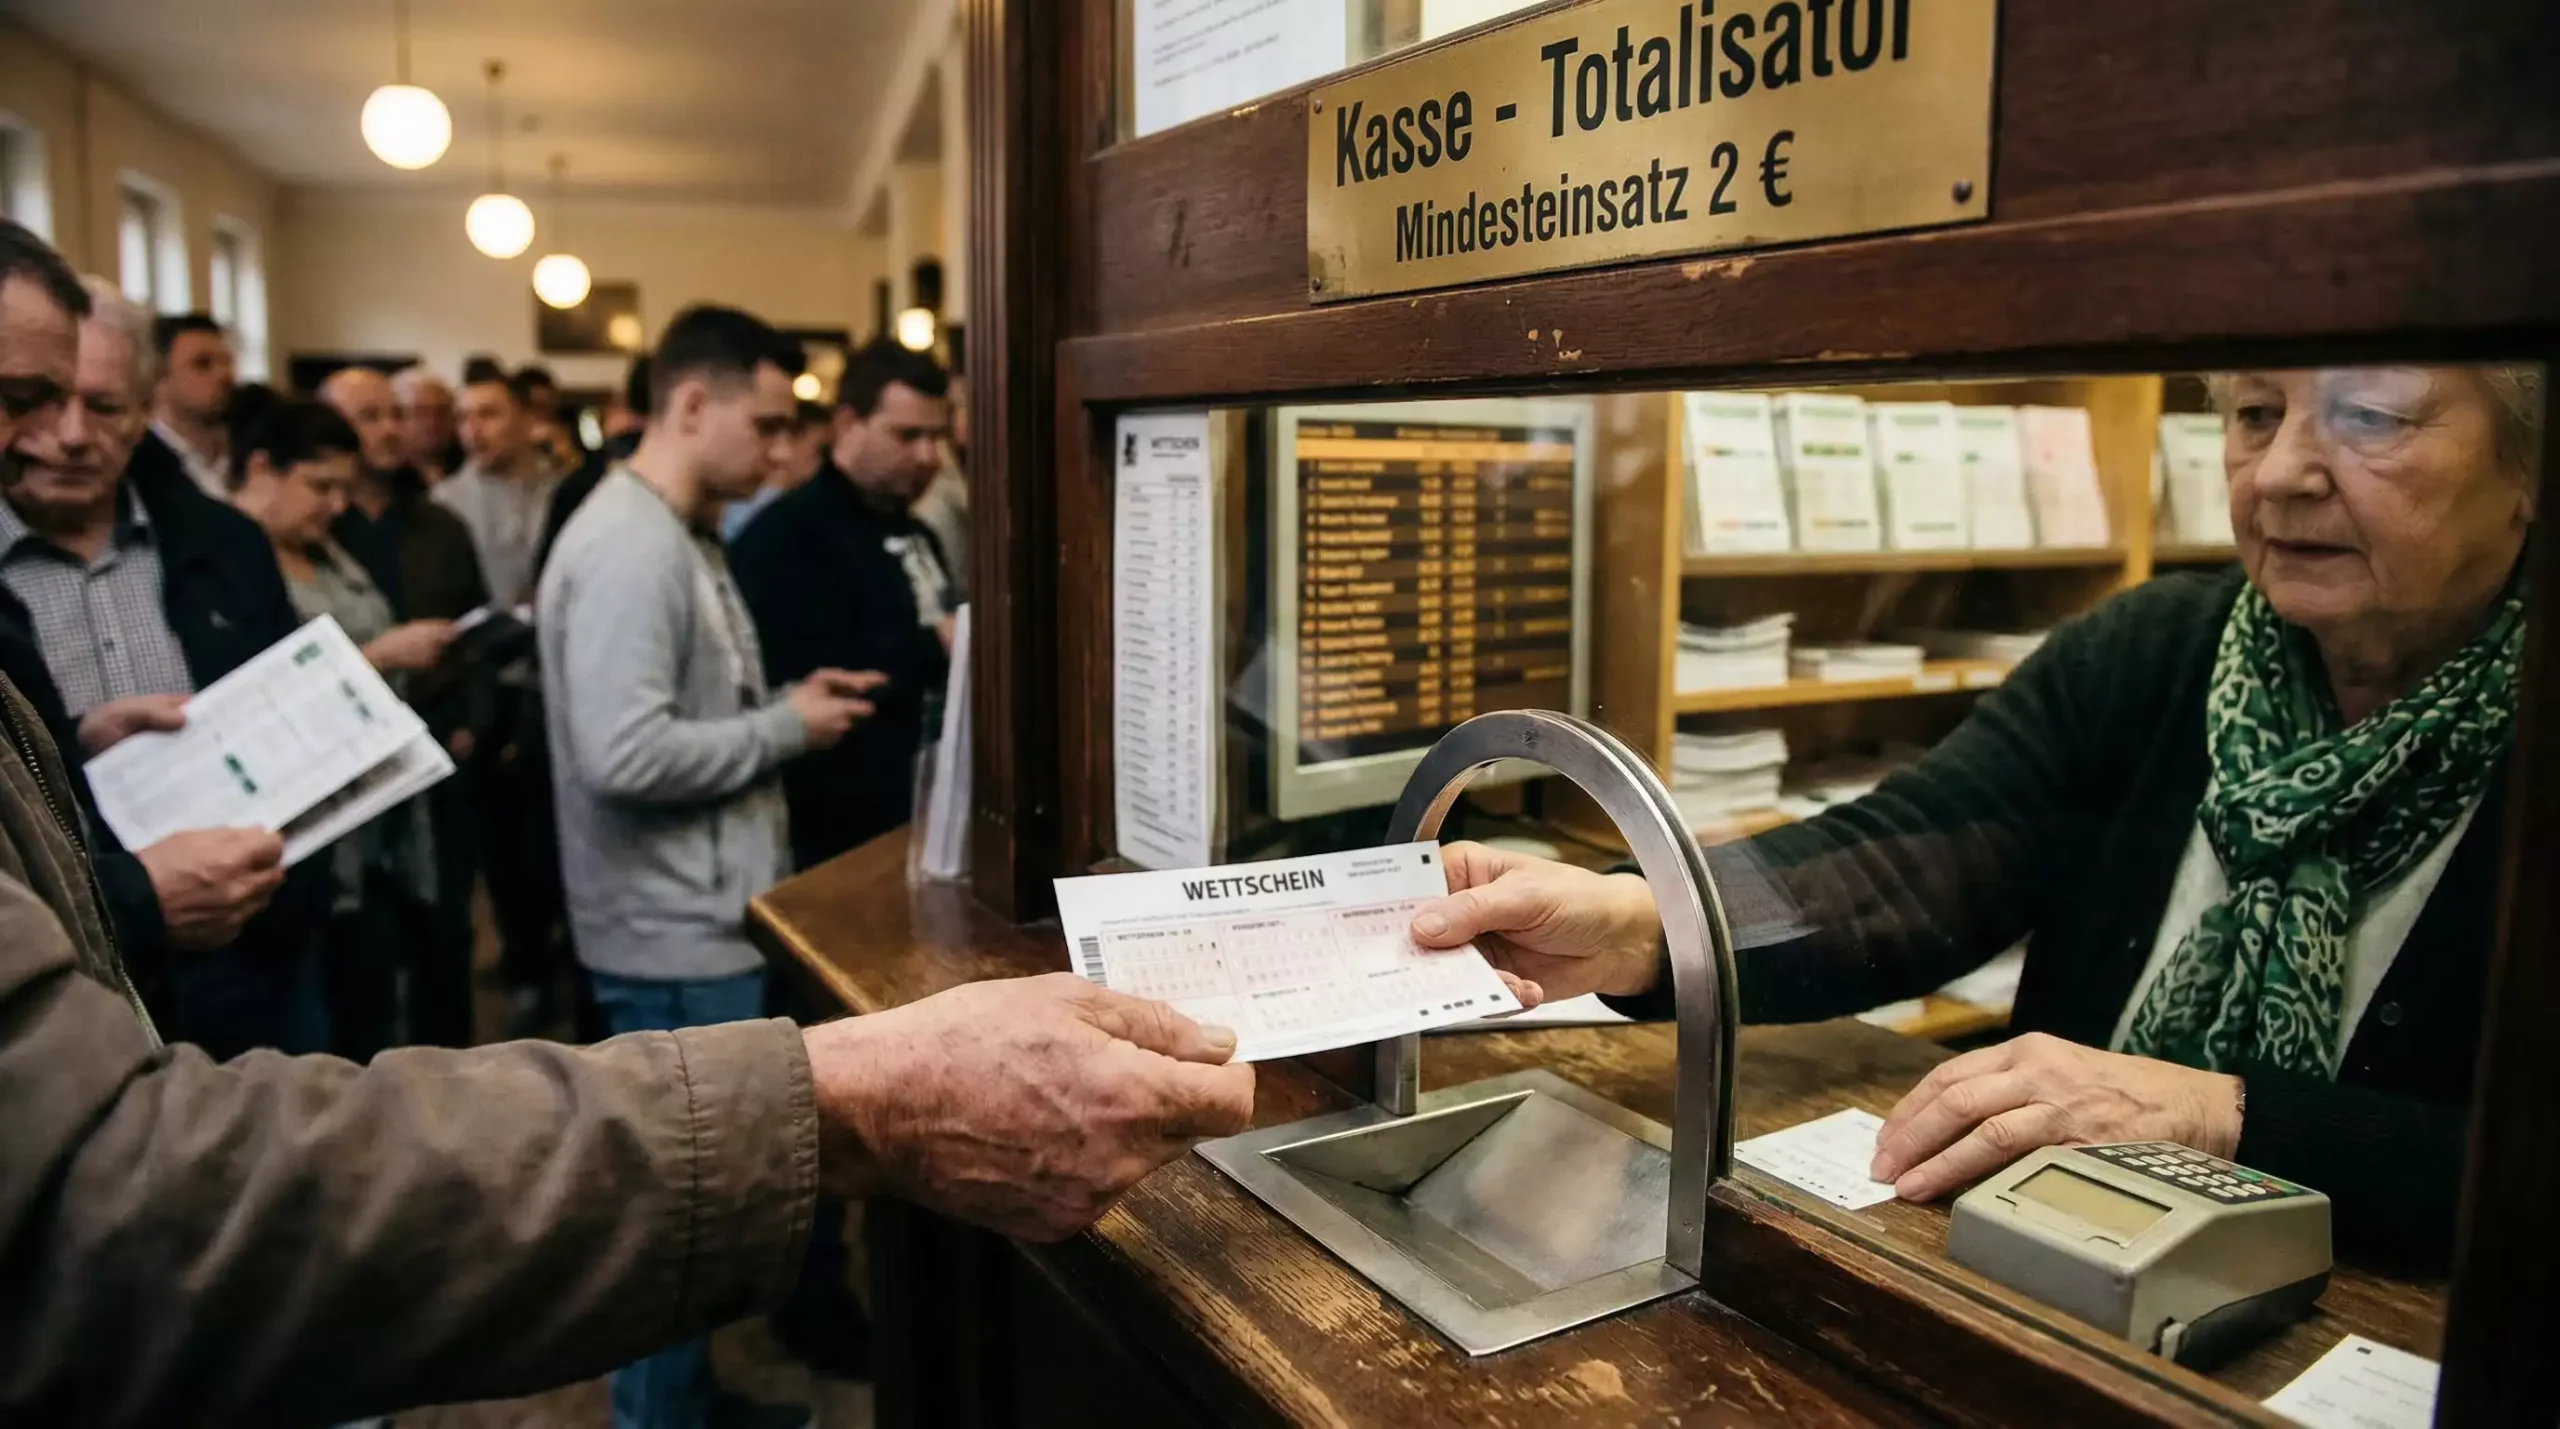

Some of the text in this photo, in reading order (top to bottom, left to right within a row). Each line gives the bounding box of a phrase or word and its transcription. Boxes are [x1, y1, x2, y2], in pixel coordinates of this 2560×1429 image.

[1336, 0, 1910, 188] Kasse - Totalisator
[1396, 130, 1795, 263] Mindesteinsatz 2 €
[1182, 869, 1325, 901] WETTSCHEIN
